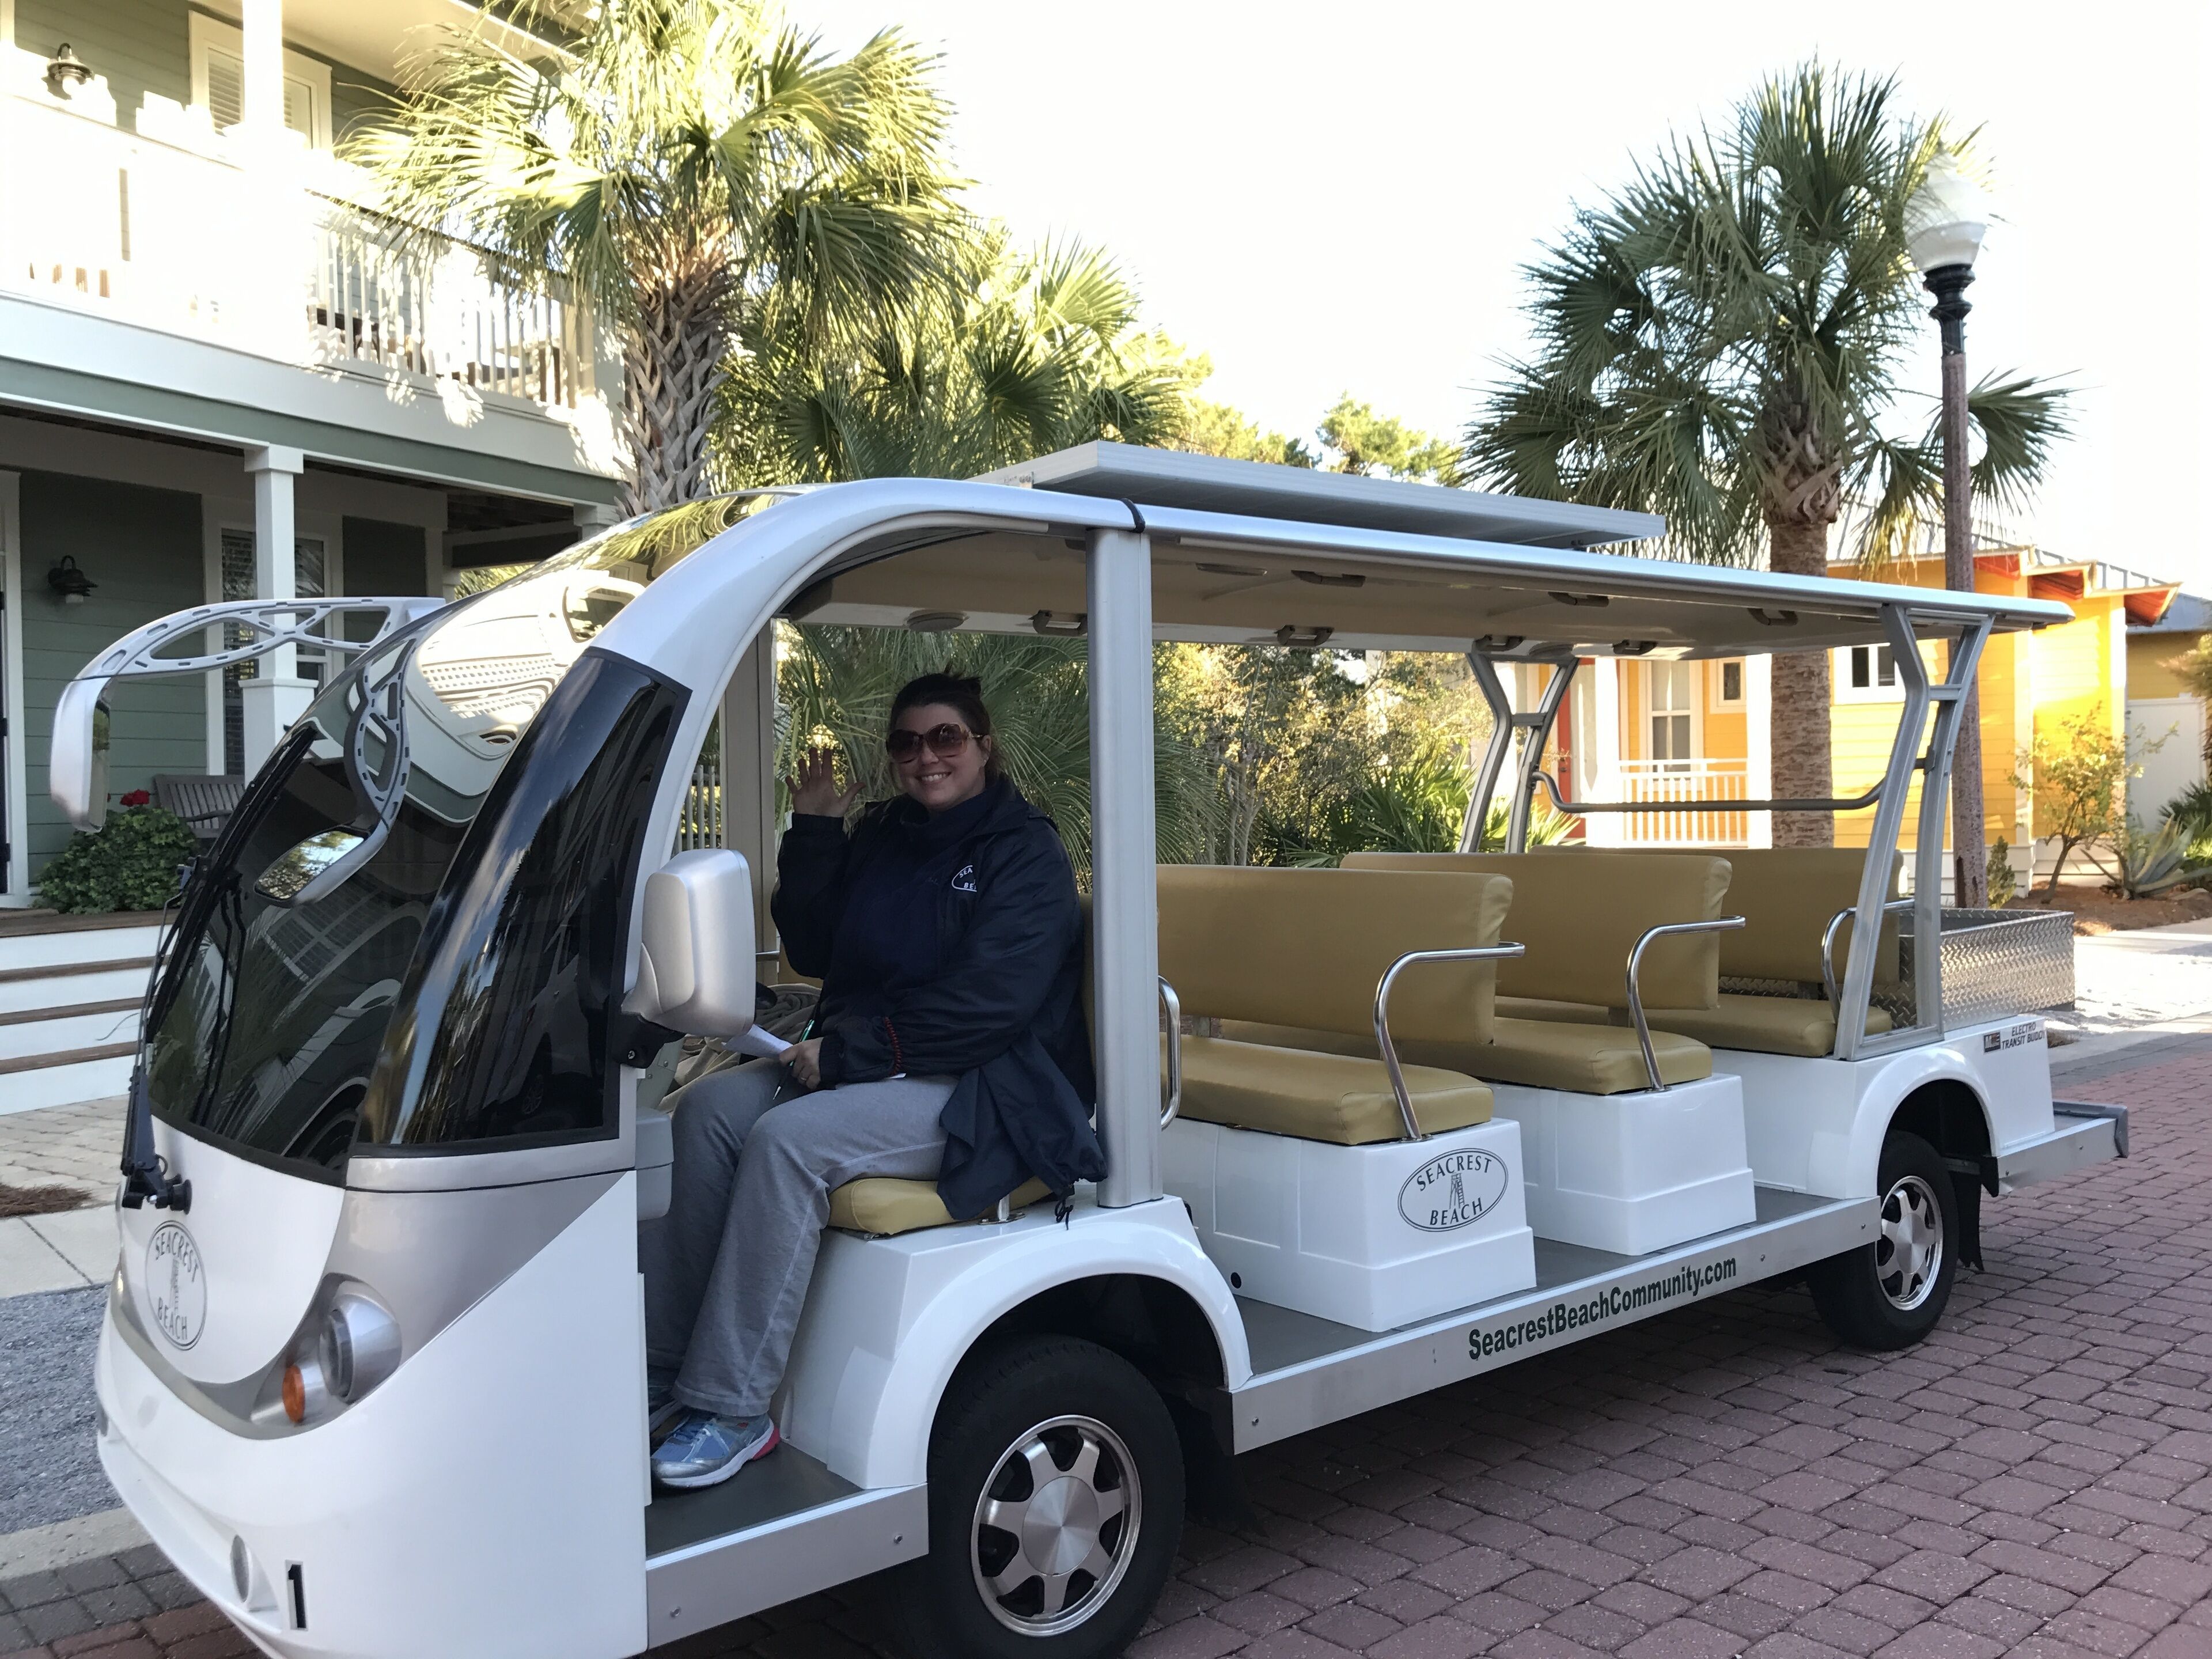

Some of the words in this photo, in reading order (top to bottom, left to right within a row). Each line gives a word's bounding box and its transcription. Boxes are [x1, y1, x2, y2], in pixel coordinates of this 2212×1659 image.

[2002, 1035, 2026, 1050] TRANSIT
[2012, 1022, 2036, 1036] ELECTRO
[1416, 1154, 1492, 1192] SEACREST
[1430, 1197, 1483, 1226] BEACH
[155, 1230, 199, 1283] SEACREST
[157, 1296, 188, 1340] BEACH
[1468, 1257, 1737, 1361] SeacrestBeachCommunity.com
[288, 1563, 306, 1628] 1
